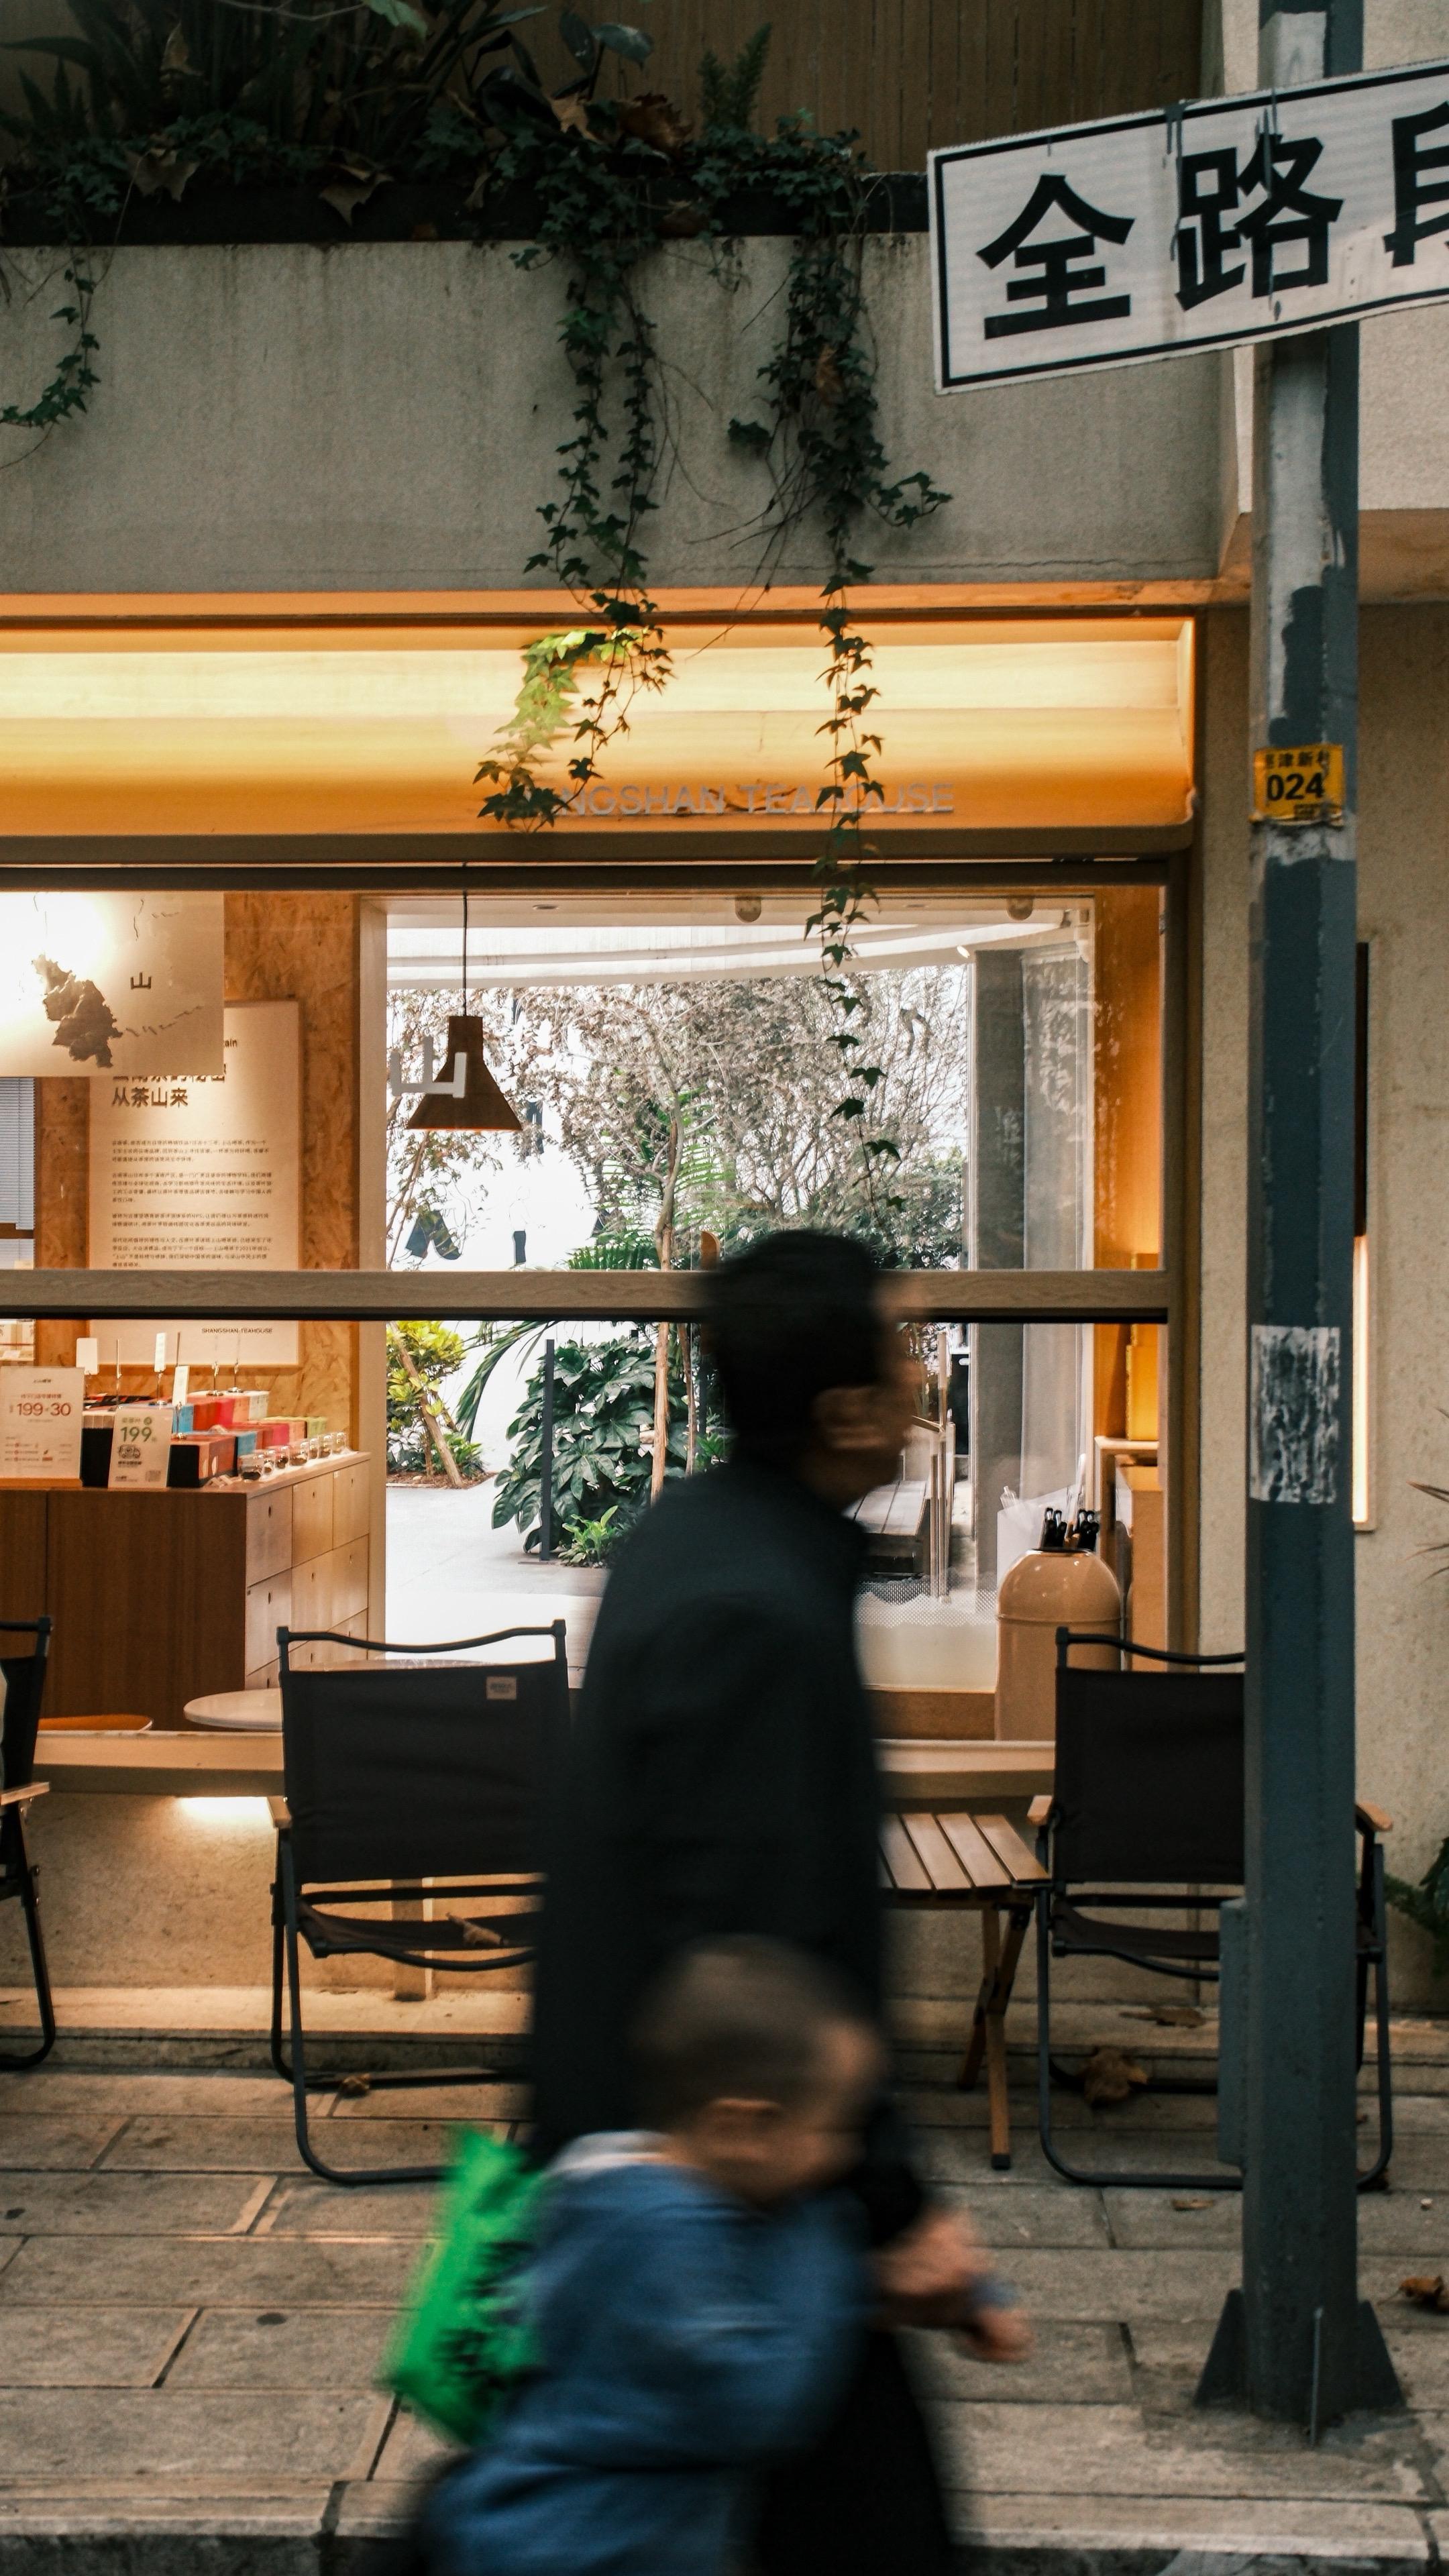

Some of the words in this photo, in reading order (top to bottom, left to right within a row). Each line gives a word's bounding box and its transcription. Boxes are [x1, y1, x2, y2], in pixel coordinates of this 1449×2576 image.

[1267, 773, 1326, 801] 024
[131, 972, 152, 989] 山
[111, 1087, 189, 1108] 从茶山来
[17, 1403, 43, 1416] 199
[121, 1426, 152, 1442] 199
